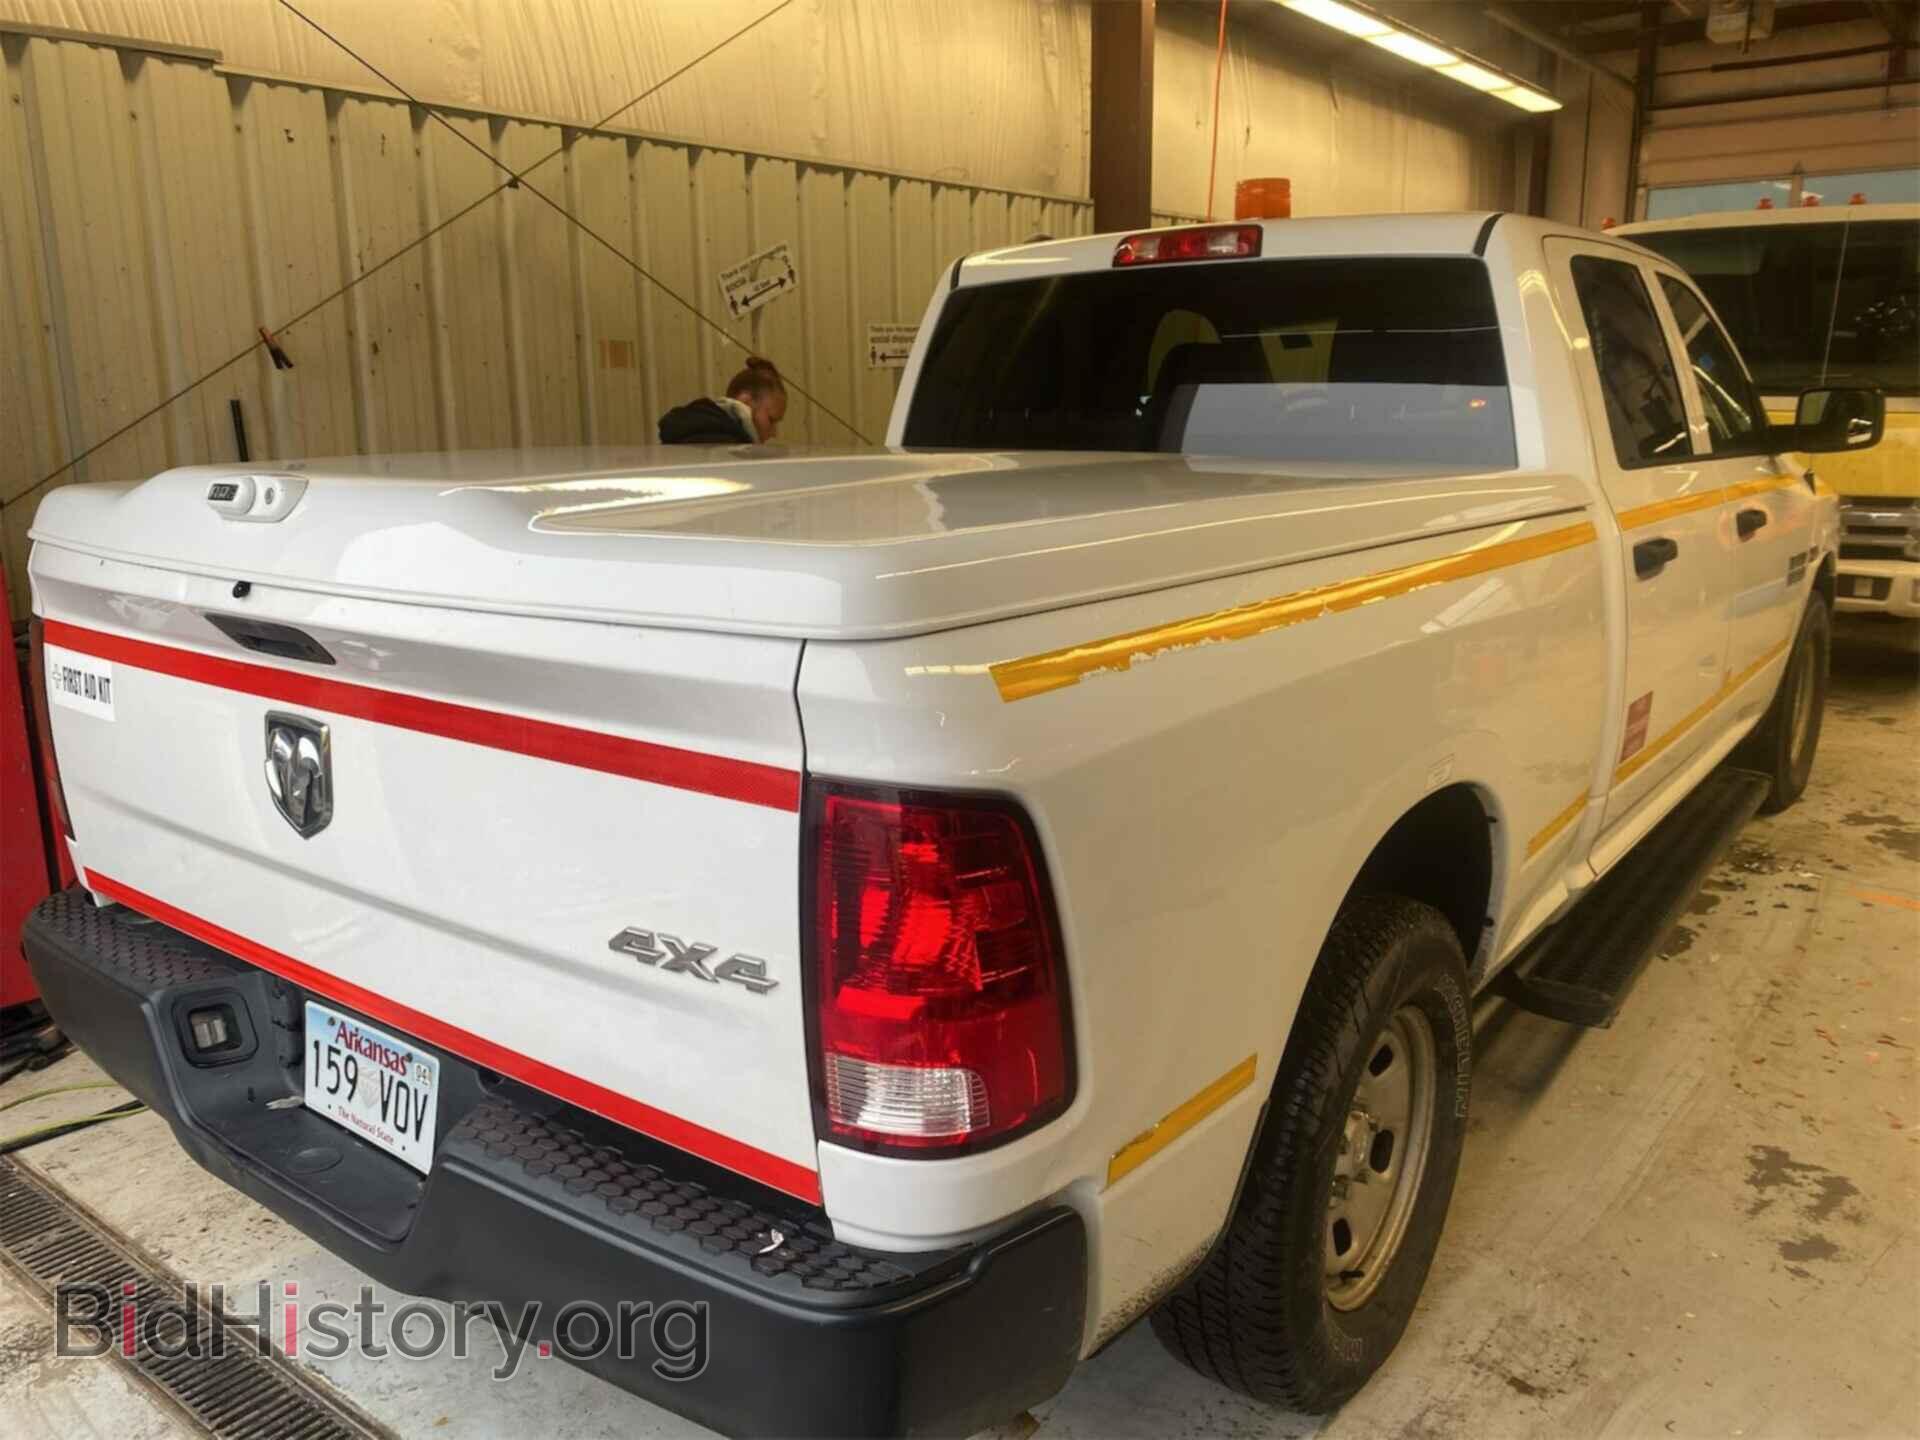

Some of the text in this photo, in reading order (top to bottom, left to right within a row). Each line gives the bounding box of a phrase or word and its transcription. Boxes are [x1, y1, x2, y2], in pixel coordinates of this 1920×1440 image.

[63, 666, 111, 704] FIRST AID KIT
[335, 1021, 407, 1076] Arkansas
[313, 1040, 429, 1143] 159 VOV
